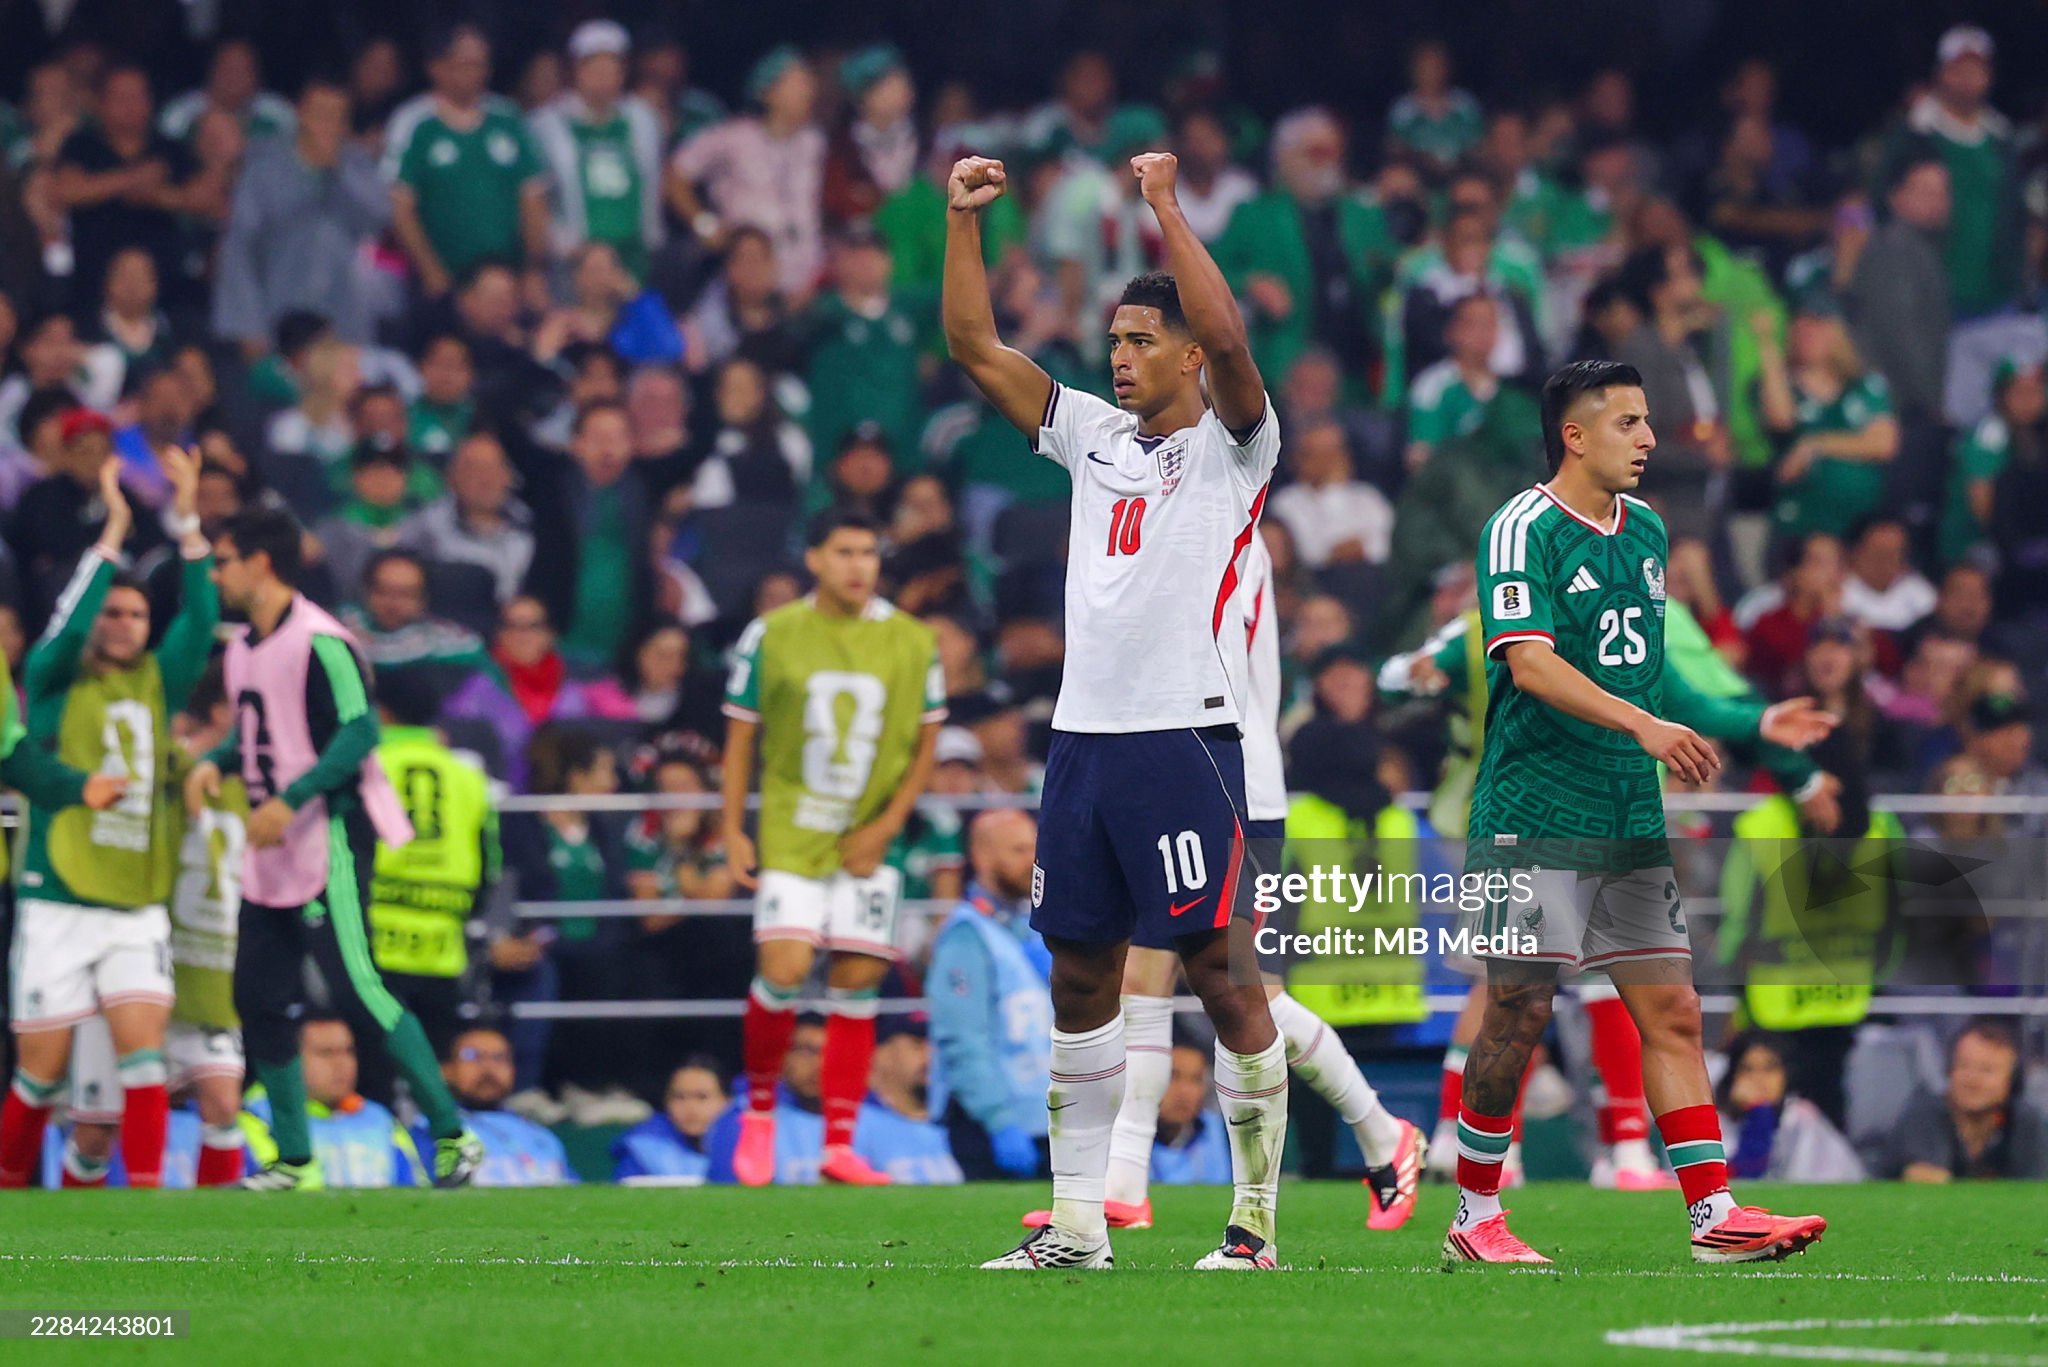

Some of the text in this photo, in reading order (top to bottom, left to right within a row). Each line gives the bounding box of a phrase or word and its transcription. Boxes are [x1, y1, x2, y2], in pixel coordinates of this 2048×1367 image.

[1107, 497, 1147, 556] 10
[1598, 606, 1647, 666] 25
[1157, 830, 1208, 894] 10
